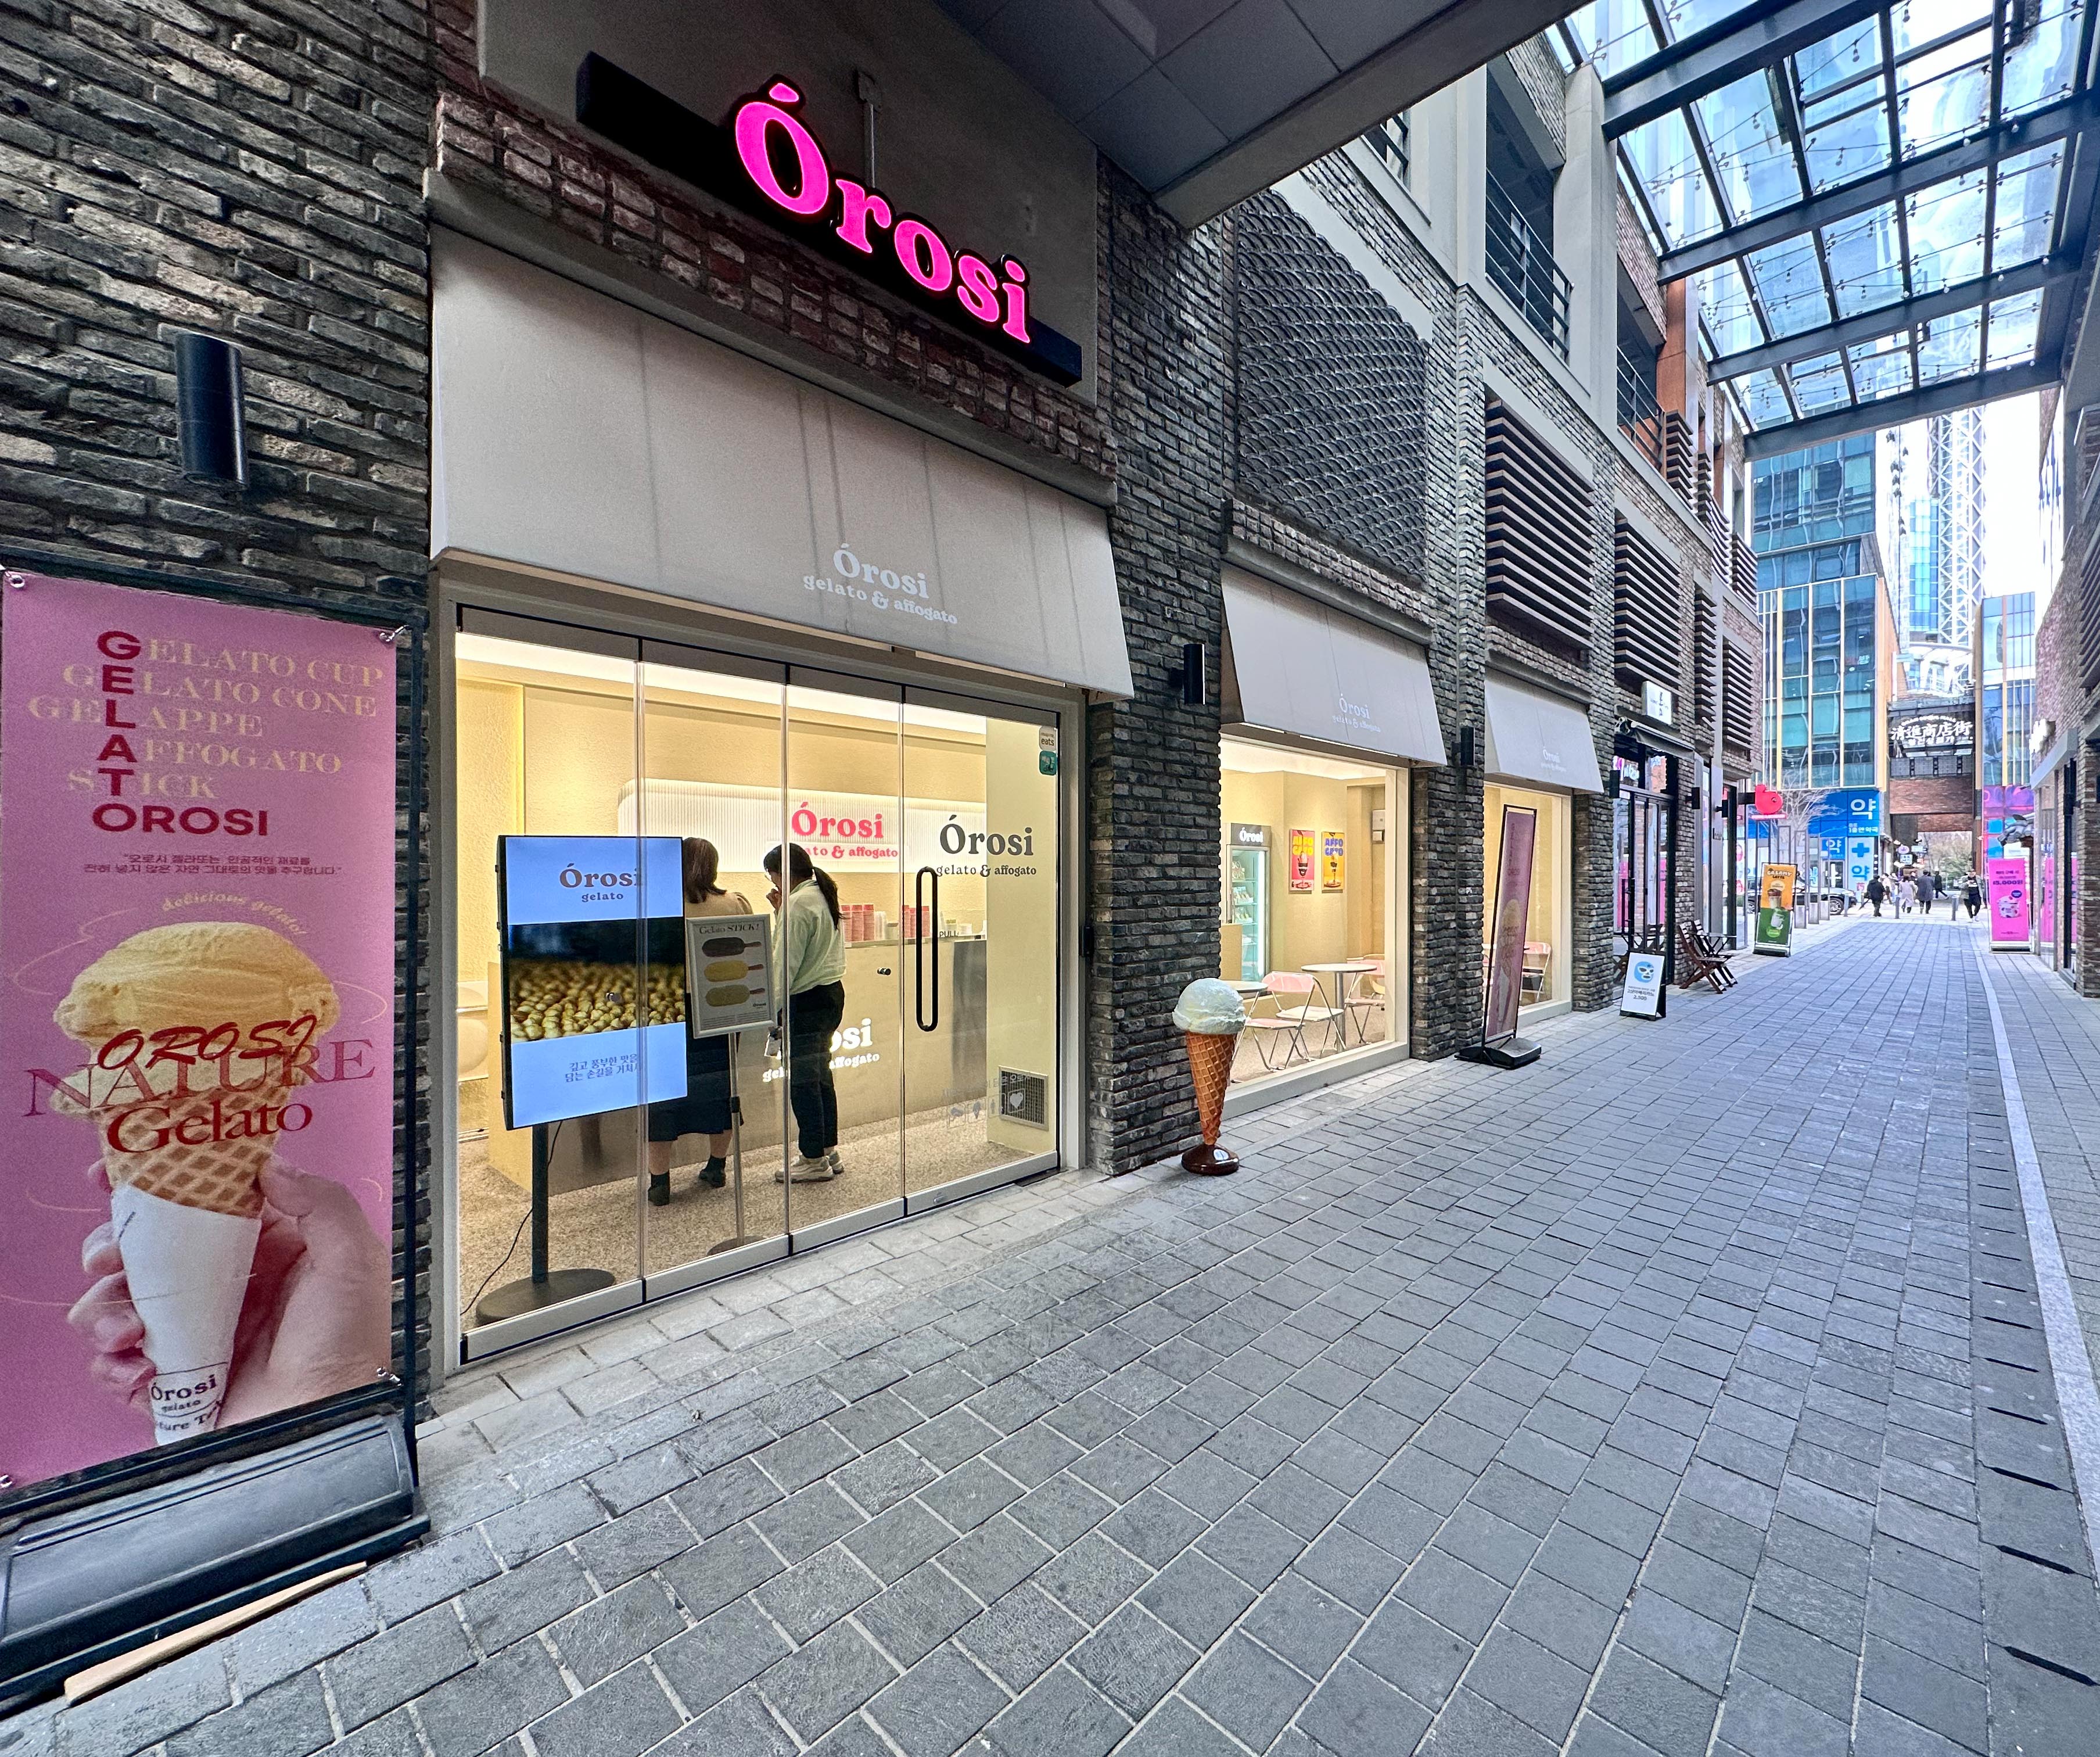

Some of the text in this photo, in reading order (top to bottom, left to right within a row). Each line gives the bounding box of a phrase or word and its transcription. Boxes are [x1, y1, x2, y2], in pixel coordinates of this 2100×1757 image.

[735, 83, 1030, 343] Órosi
[833, 543, 929, 599] Órosi
[803, 575, 958, 625] gelato & affogato
[307, 659, 383, 688] CUP
[272, 686, 378, 717] CONE
[1041, 738, 1054, 746] eats
[92, 803, 268, 837] OROSI
[791, 801, 884, 838] Órosi
[1850, 798, 1877, 820] 약
[940, 814, 1034, 856] Órosi
[1325, 838, 1344, 847] AFFO
[1825, 840, 1841, 854] 약
[806, 846, 898, 859] ato & affogato
[936, 864, 1037, 877] gelato & affogato
[1851, 865, 1870, 881] 약
[581, 892, 624, 902] gelato
[21, 1039, 375, 1117] NATURE
[569, 1061, 588, 1072] 깊고
[591, 1056, 617, 1069] 풍부한
[106, 1100, 313, 1153] Gelato
[150, 1374, 217, 1401] Órosi
